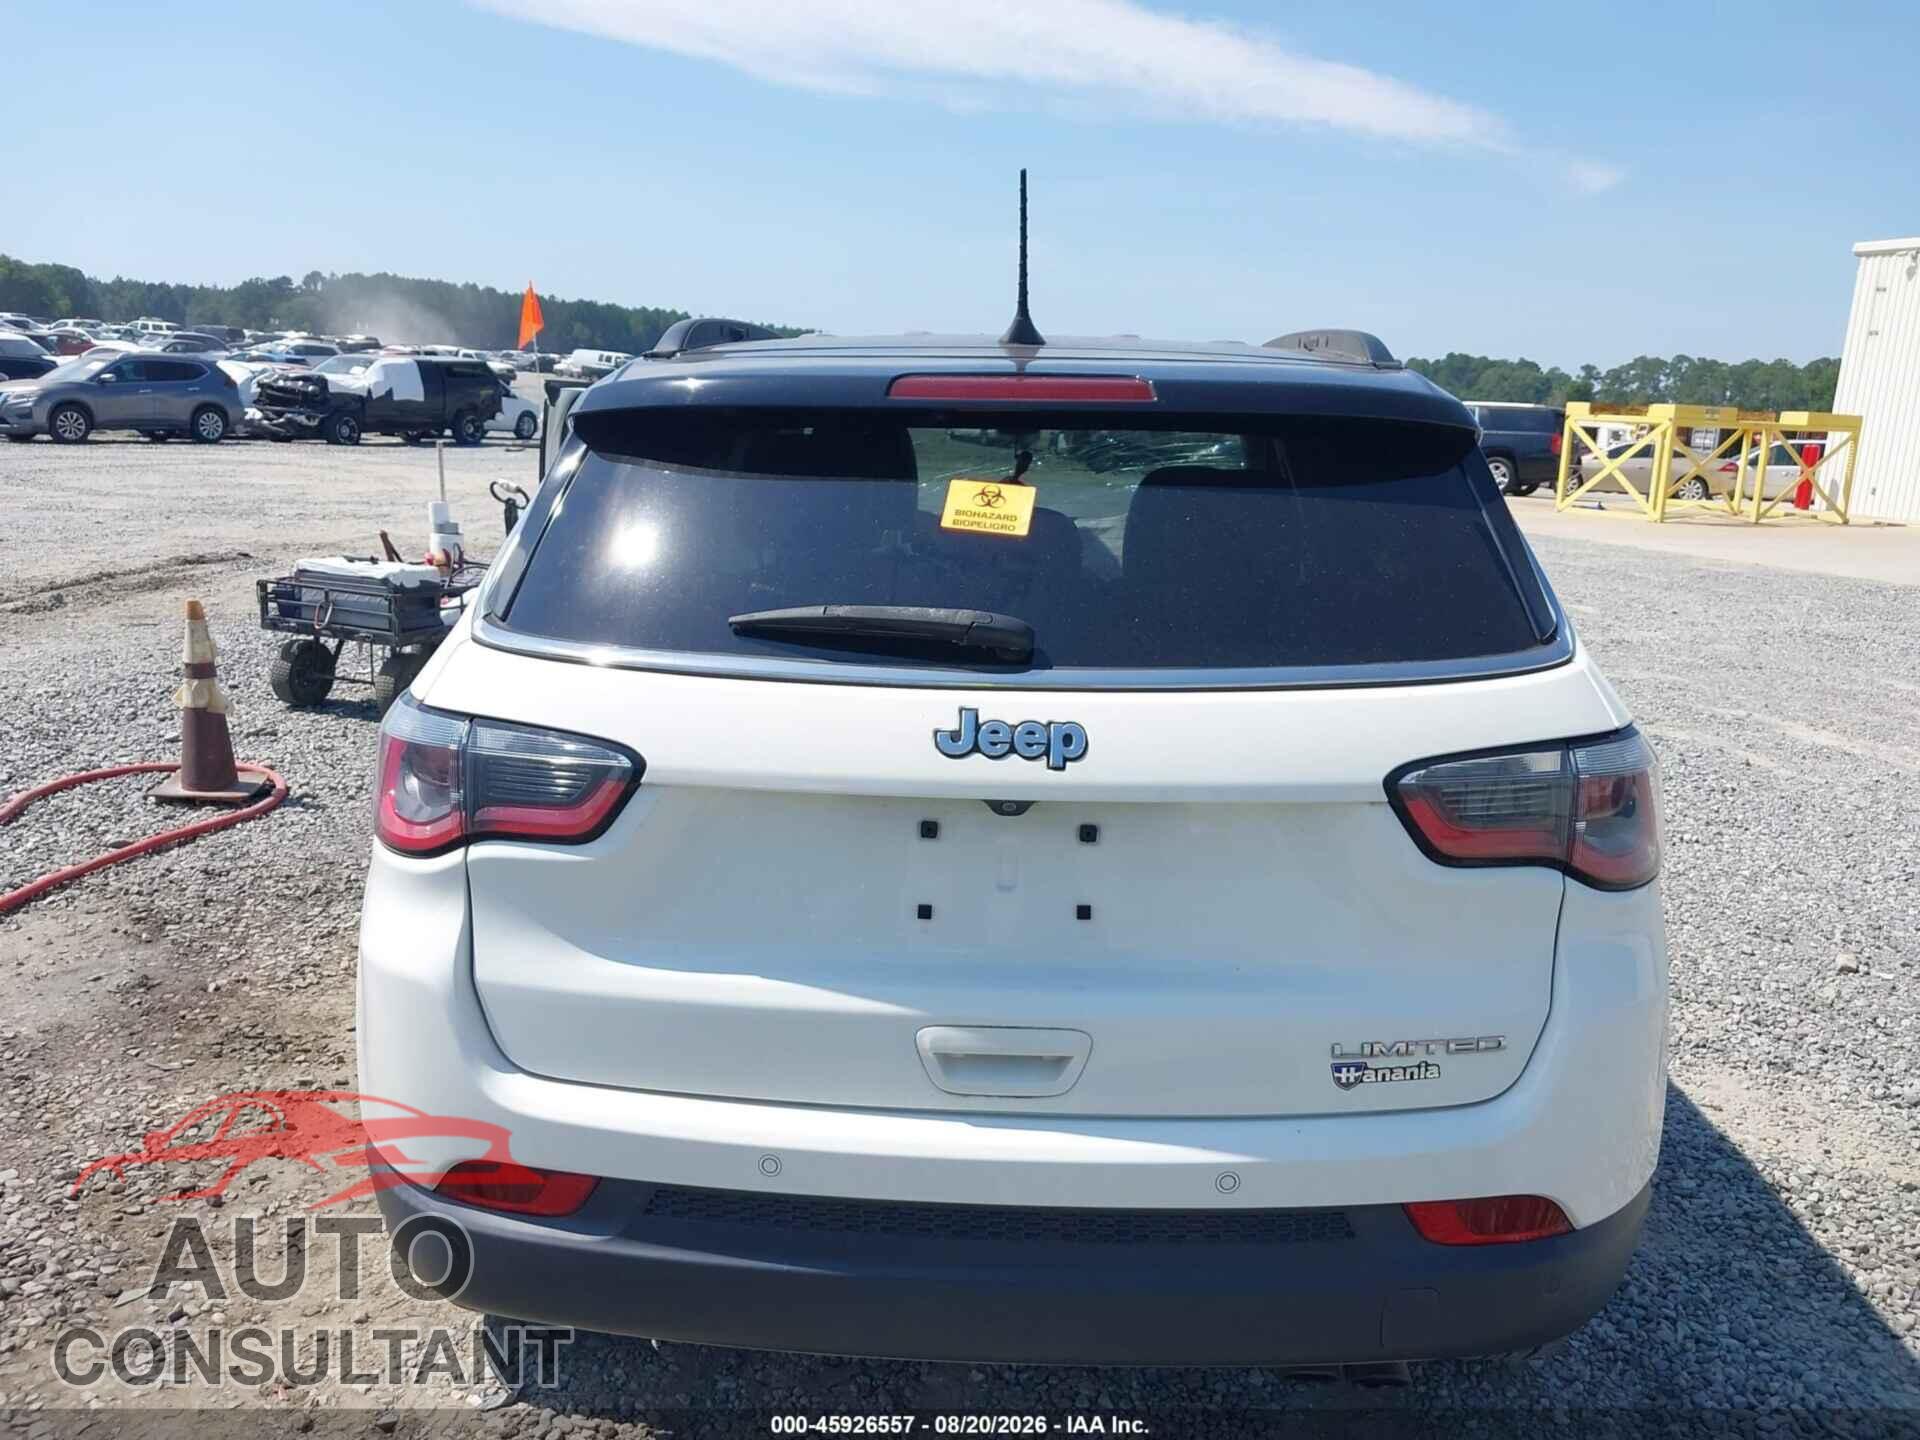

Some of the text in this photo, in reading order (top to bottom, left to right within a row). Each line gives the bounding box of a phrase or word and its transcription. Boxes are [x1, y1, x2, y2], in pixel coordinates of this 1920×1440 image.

[952, 518, 1016, 531] BIOPELIGRO
[954, 509, 1017, 521] BIOHAZARD
[934, 706, 1088, 771] Jeep
[1331, 1035, 1505, 1058] LIMITED
[1331, 1061, 1440, 1089] Hanania
